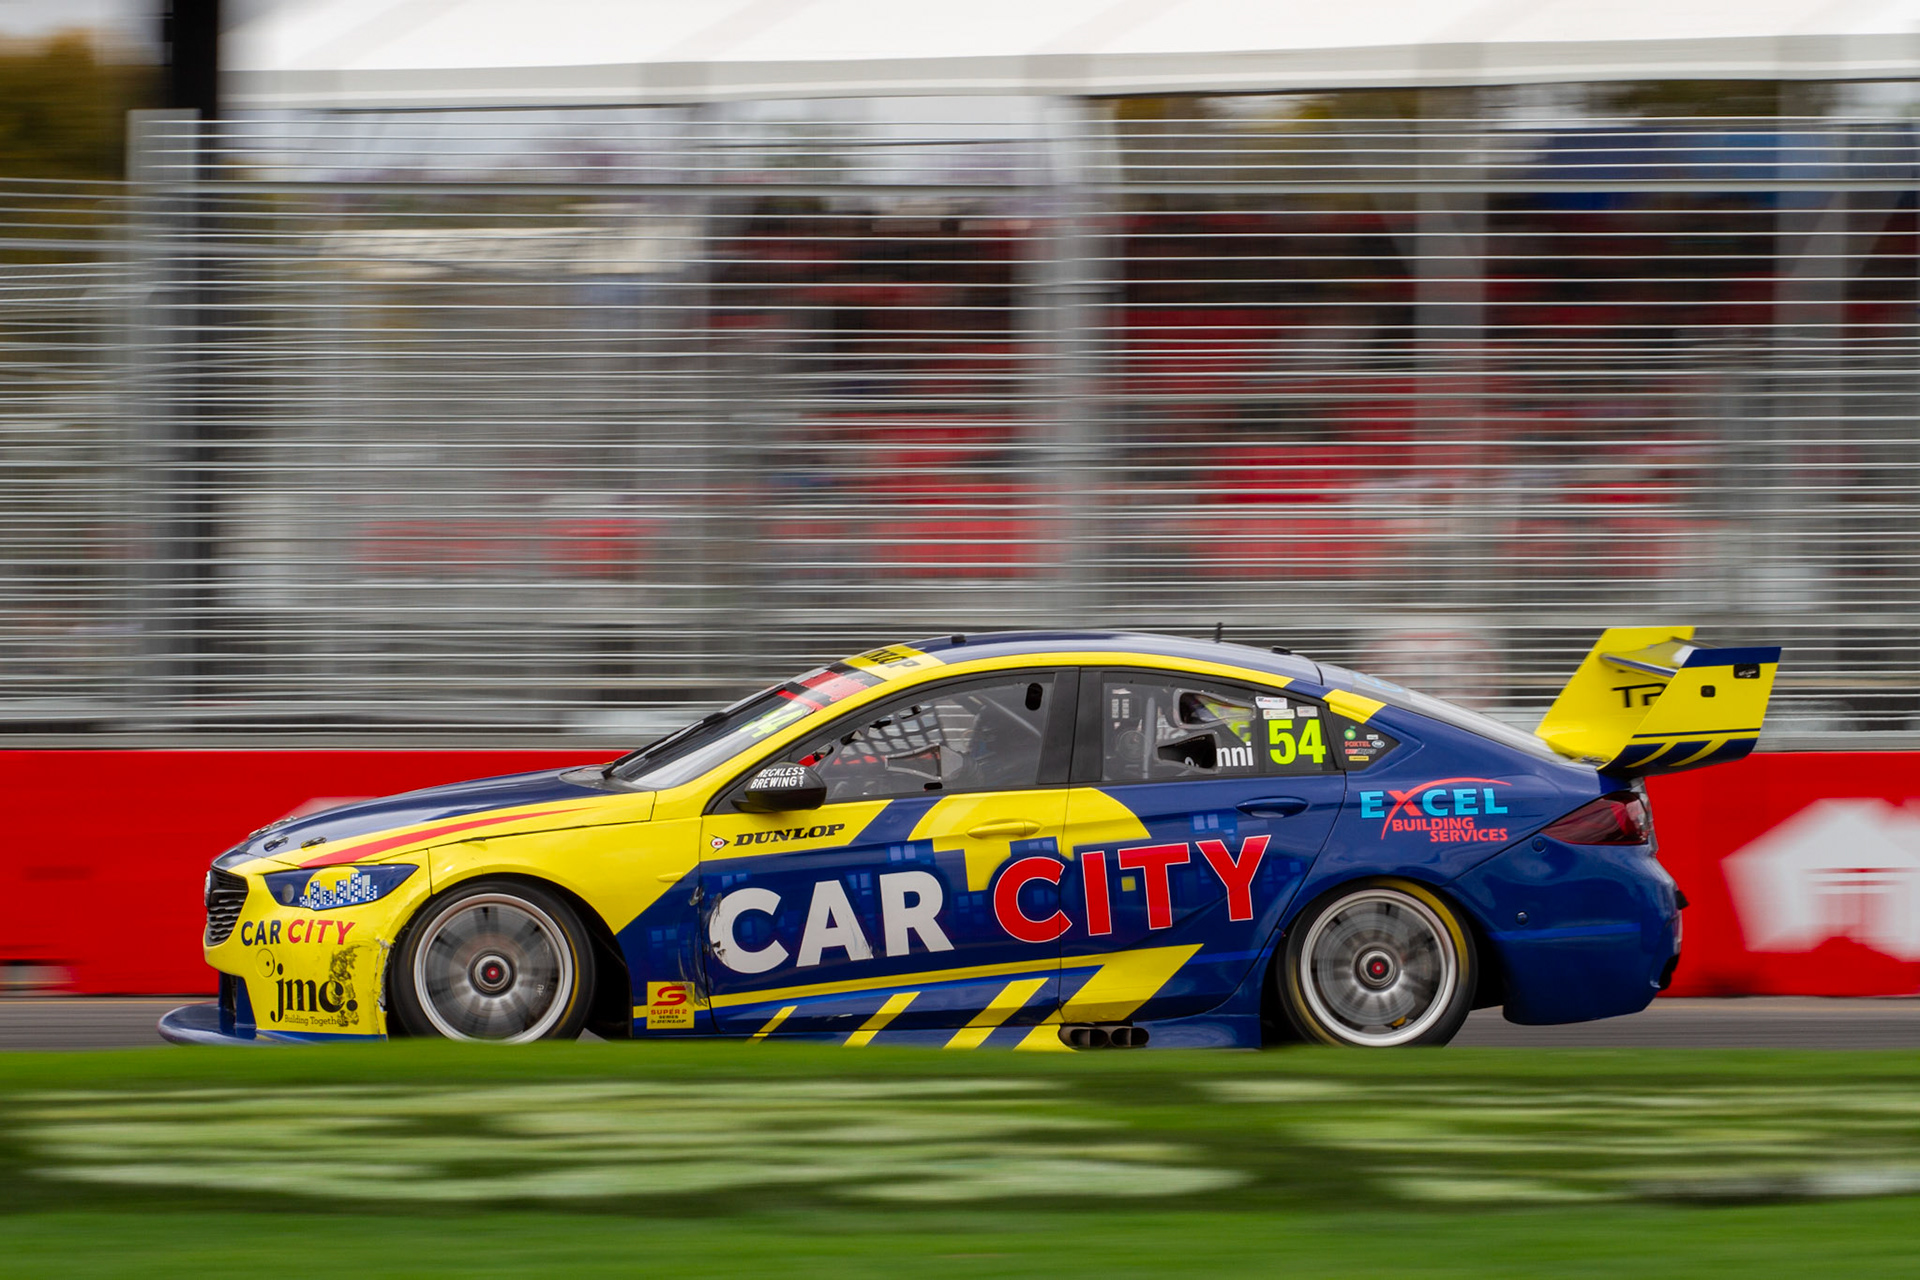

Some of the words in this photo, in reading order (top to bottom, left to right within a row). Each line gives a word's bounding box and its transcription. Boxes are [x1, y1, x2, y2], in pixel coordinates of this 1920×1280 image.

[1268, 719, 1327, 765] 54
[757, 766, 806, 778] RECKLESS
[750, 776, 798, 789] BREWING
[1359, 786, 1508, 819] EXCEL
[1391, 817, 1475, 832] BUILDING
[733, 823, 845, 847] DUNLOP
[1429, 828, 1509, 843] SERVICES
[708, 870, 956, 975] CAR
[993, 834, 1272, 944] CITY
[241, 920, 282, 947] CAR
[287, 918, 356, 945] CITY
[284, 1014, 309, 1026] Building
